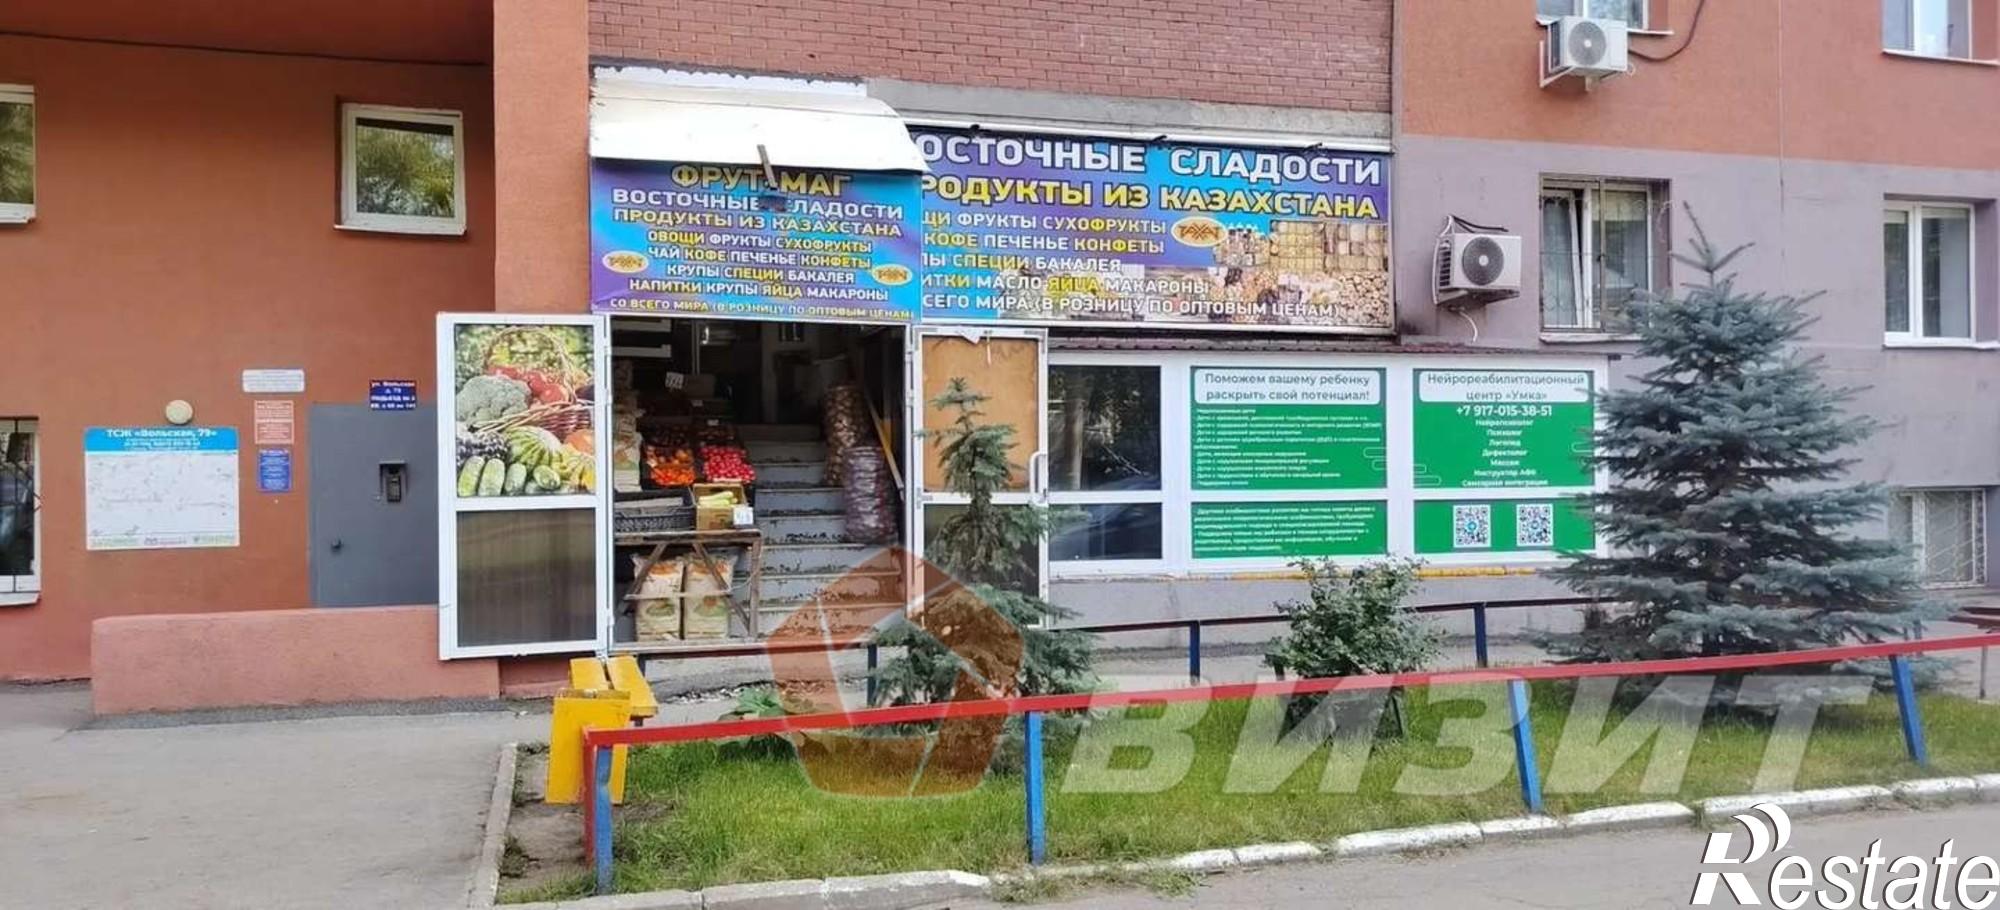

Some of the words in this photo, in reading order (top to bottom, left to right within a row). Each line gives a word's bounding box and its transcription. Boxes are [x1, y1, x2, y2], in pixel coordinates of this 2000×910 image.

[915, 134, 1145, 171] ОСТОЧНЫЕ
[1170, 149, 1380, 184] СЛАДОСТИ
[612, 188, 759, 211] ВОСТОЧНЫЕ
[786, 199, 903, 219] ЛАДОСТИ
[922, 174, 1091, 206] РОДУКТЫ
[1104, 184, 1149, 208] ИЗ
[1160, 187, 1379, 218] КАЗАХСТАНА
[614, 208, 732, 227] ПРОДУКТЫ
[740, 215, 765, 229] ИЗ
[773, 217, 902, 236] КАЗАХСТАНА
[958, 212, 1036, 229] ФРУКТЫ
[1042, 216, 1166, 234] СУХОФРУКТЫ
[648, 230, 705, 245] ОВОЩИ
[709, 233, 771, 248] ФРУКТЫ
[775, 237, 872, 253] СУХОФРУКТЫ
[924, 232, 978, 247] КОФЕ
[984, 235, 1069, 250] ПЕЧЕНЬЕ
[1074, 237, 1165, 253] КОНФЕТЫ
[648, 246, 680, 259] ЧАЙ
[684, 249, 726, 261] КОФЕ
[731, 251, 797, 265] ПЕЧЕНЬЕ
[801, 255, 871, 268] КОНФЕТЫ
[952, 253, 1030, 271] СПЕЦИИ
[1035, 256, 1122, 272] БАКАЛЕЯ
[667, 264, 720, 277] КРУПЫ
[725, 267, 783, 281] СПЕЦИИ
[788, 270, 855, 283] БАКАЛЕЯ
[977, 275, 1042, 290] МАСЛО
[1048, 274, 1099, 292] ЯЙЦА
[1105, 279, 1208, 294] МАКАРОНЫ
[629, 279, 701, 293] НАПИТКИ
[706, 283, 758, 295] КРУПЫ
[762, 284, 802, 299] ЯЙЦА
[807, 287, 889, 300] МАКАРОНЫ
[610, 298, 627, 308] СО
[630, 299, 670, 309] ВСЕГО
[674, 300, 709, 311] МИРА
[808, 306, 867, 317] ОПТОВЫМ
[922, 294, 970, 308] СЕГО
[975, 295, 1028, 310] МИРА
[1060, 299, 1143, 313] РОЗНИЦУ
[1150, 300, 1173, 313] ПО
[1180, 301, 1267, 315] ОПТОВЫМ
[1272, 303, 1339, 317] ЦЕНАМ)
[1205, 373, 1265, 384] Поможем
[1268, 375, 1317, 386] вашему
[1320, 373, 1370, 386] ребенку
[1428, 373, 1584, 385] Нейрореабилитационный
[1206, 391, 1265, 402] раскрыть
[1268, 389, 1298, 400] свой
[1301, 390, 1370, 402] потенциал!
[1466, 391, 1503, 402] центр
[1506, 390, 1547, 401] «Умка»
[1456, 405, 1471, 416] +7
[1474, 405, 1552, 417] 917-015-38-51
